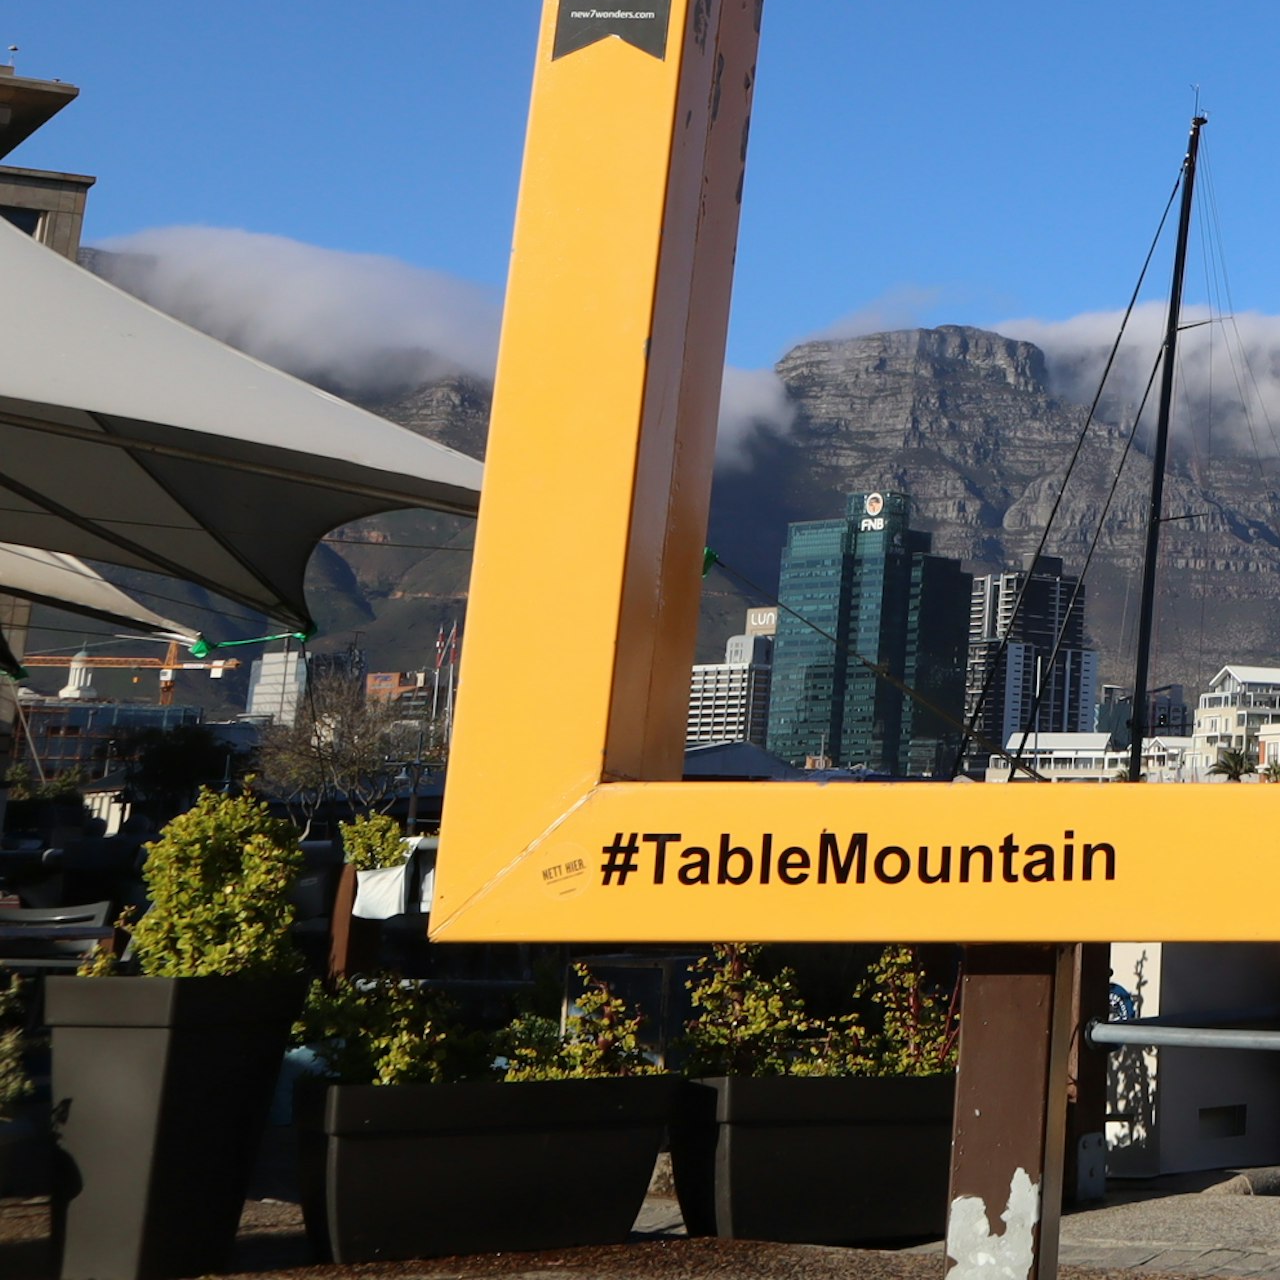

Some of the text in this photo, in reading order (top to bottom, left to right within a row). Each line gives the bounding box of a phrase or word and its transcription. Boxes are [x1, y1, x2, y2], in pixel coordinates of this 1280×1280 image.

[570, 9, 656, 20] new7wonders.com
[861, 517, 884, 531] FNB
[600, 829, 1116, 886] #TableMountain
